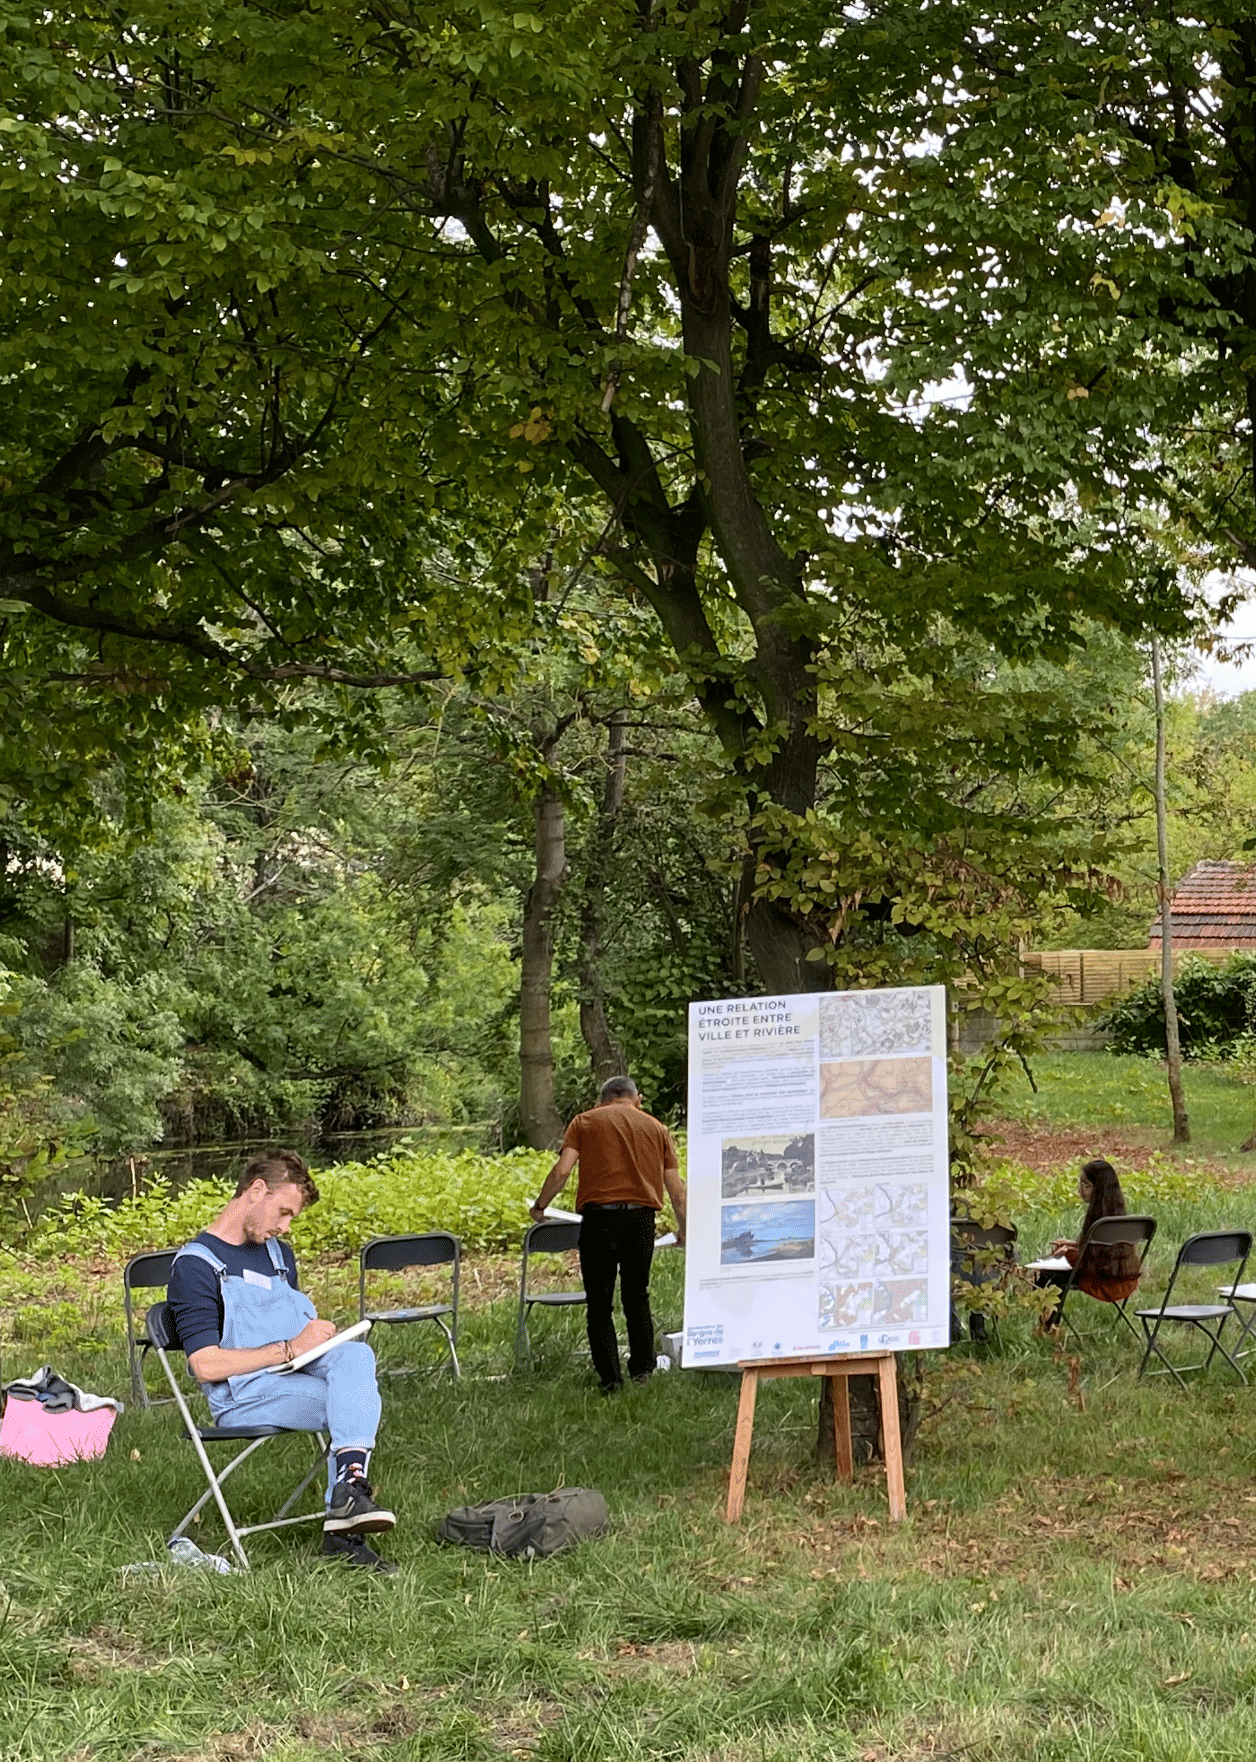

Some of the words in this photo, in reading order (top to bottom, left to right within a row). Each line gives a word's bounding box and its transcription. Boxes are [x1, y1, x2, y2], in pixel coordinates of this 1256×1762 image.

[698, 1005, 723, 1015] UNE
[727, 1000, 786, 1013] RELATION
[698, 1016, 749, 1029] ÉTROITE
[752, 1013, 792, 1025] ENTRE
[698, 1031, 731, 1041] VILLE
[735, 1029, 750, 1039] ET
[753, 1025, 801, 1038] RIVIÈRE
